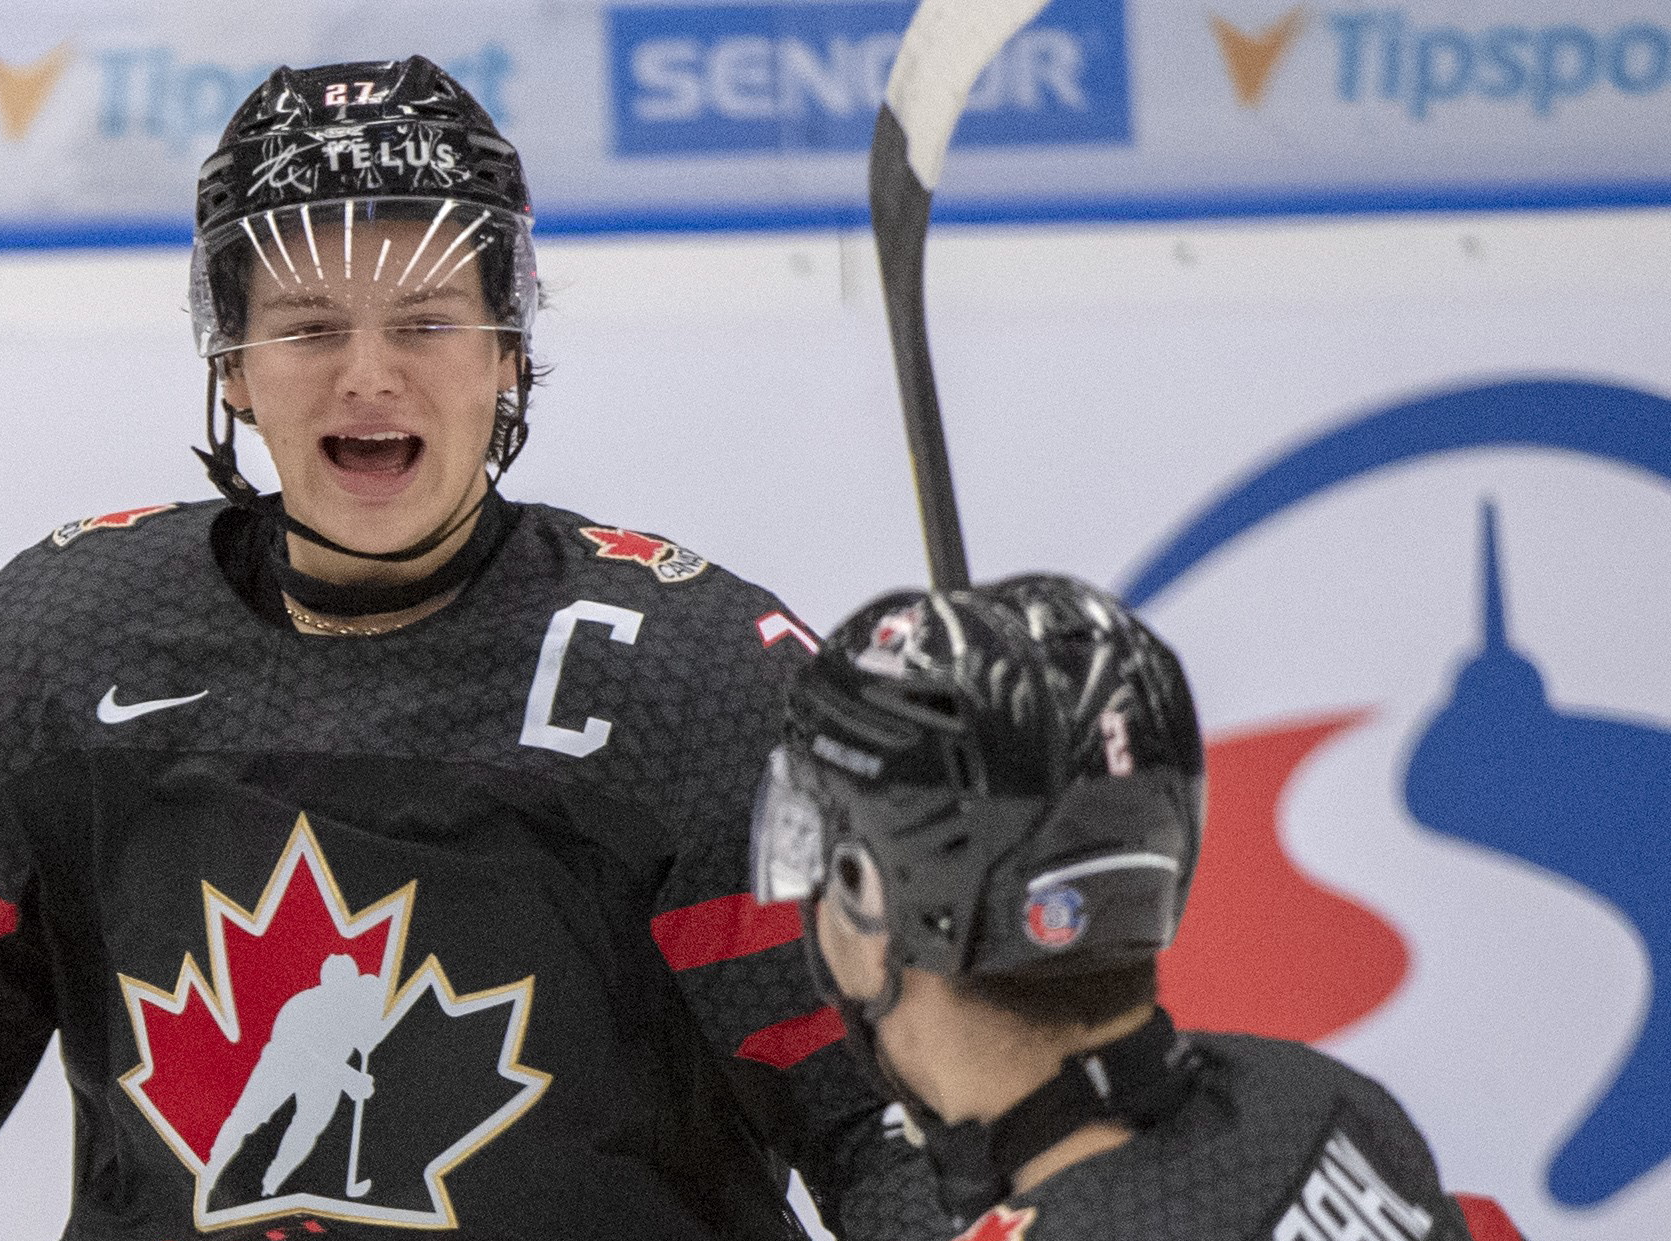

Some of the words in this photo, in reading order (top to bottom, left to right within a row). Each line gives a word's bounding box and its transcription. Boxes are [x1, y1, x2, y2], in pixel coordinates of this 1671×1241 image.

[325, 81, 376, 106] 27
[323, 141, 456, 172] TELUS
[518, 599, 644, 758] C
[1098, 708, 1135, 777] 2
